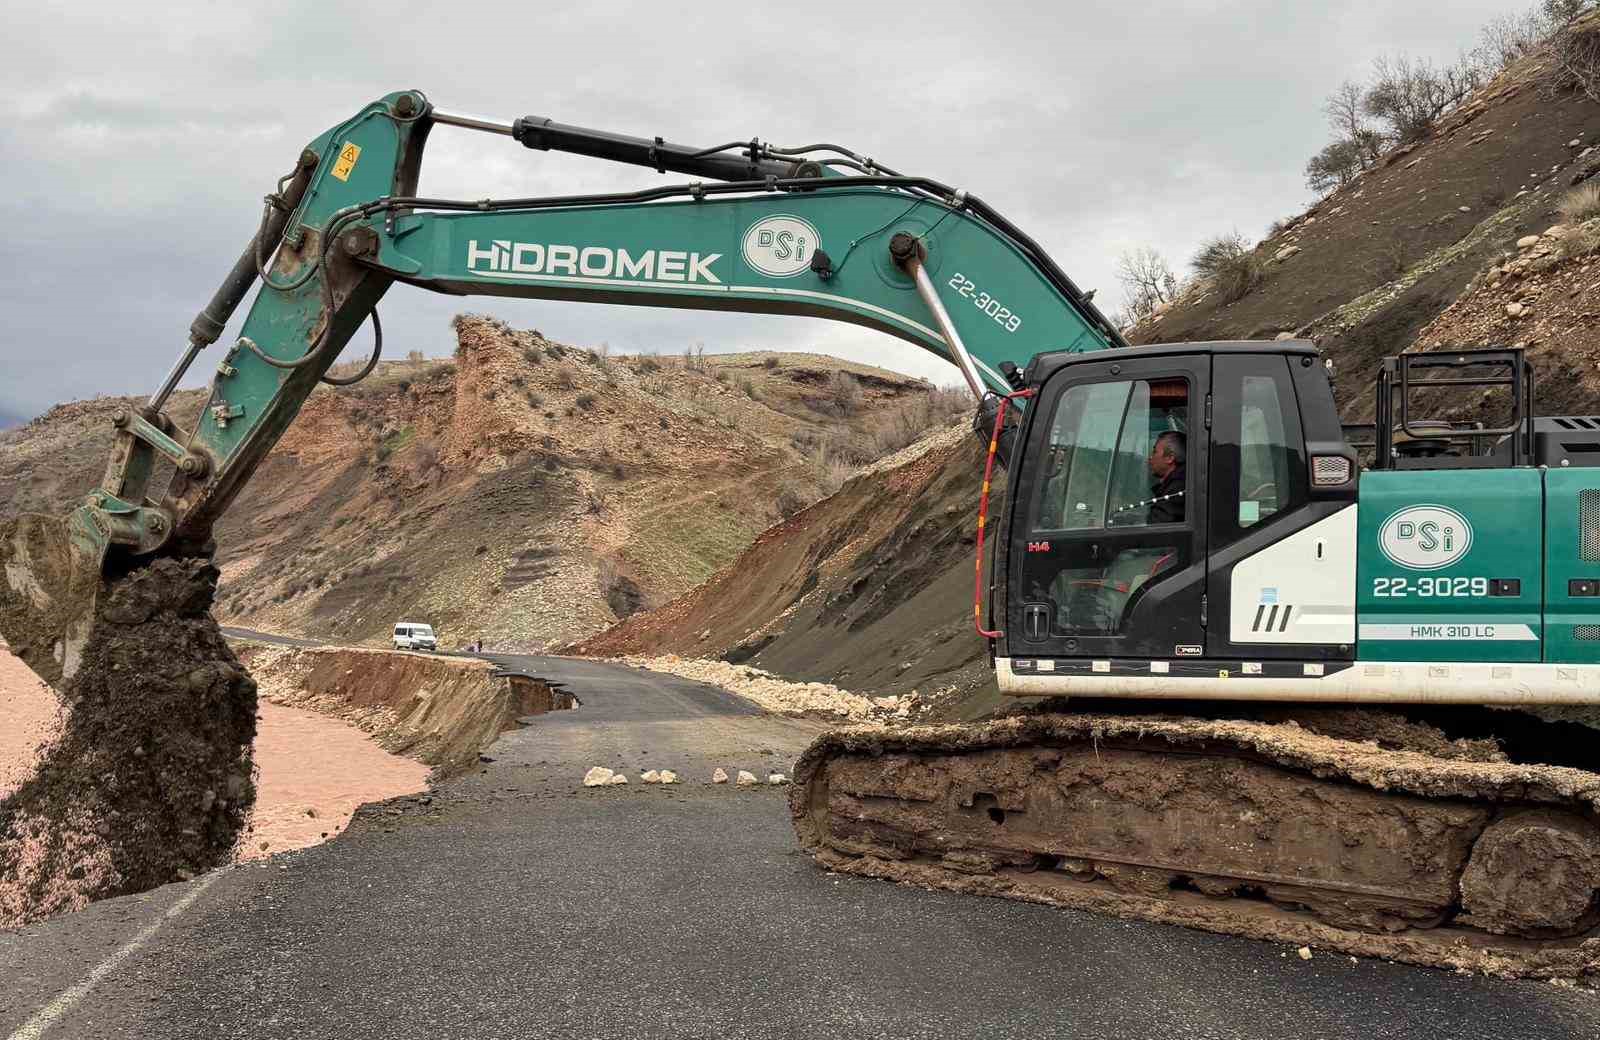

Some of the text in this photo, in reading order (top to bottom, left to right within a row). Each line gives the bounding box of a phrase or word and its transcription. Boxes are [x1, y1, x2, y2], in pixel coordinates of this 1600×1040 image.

[948, 272, 1022, 332] 22-3029
[1028, 542, 1050, 552] H4
[1373, 577, 1488, 597] 22-3029
[1410, 626, 1495, 638] HMK 310 LC
